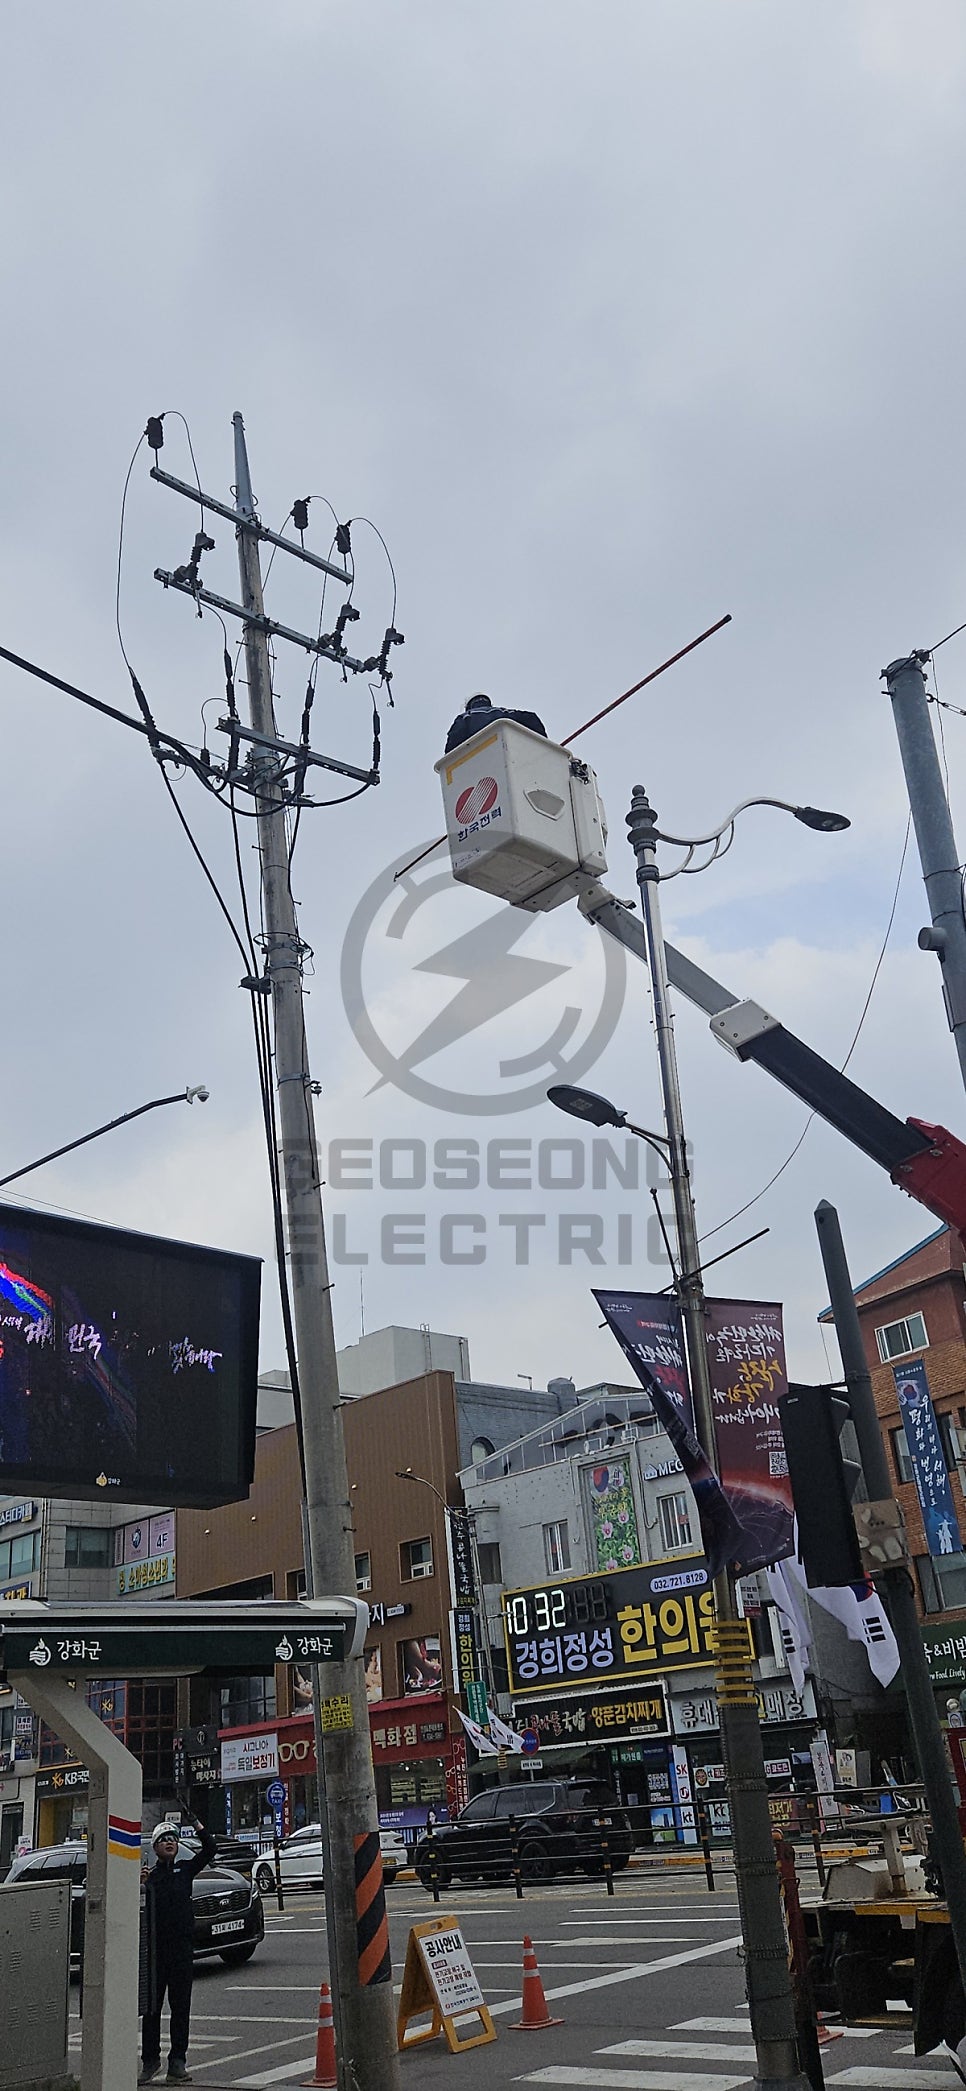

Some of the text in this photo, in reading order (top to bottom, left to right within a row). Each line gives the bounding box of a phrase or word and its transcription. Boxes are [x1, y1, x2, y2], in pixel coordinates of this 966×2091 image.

[457, 806, 502, 843] 한국전력
[157, 1532, 168, 1548] 4F
[653, 1572, 704, 1591] 032.721.8128
[535, 1589, 567, 1631] 32
[57, 1640, 102, 1661] 강화군
[297, 1637, 333, 1657] 강화군
[516, 1628, 614, 1679] 경희정성
[590, 1699, 663, 1729] 양푼김치찌개
[680, 1699, 719, 1730] 휴대
[373, 1723, 418, 1749] 백화점
[676, 1764, 688, 1775] SK
[682, 1811, 693, 1824] kt
[713, 1802, 726, 1817] kt
[425, 1934, 462, 1958] 공사안내
